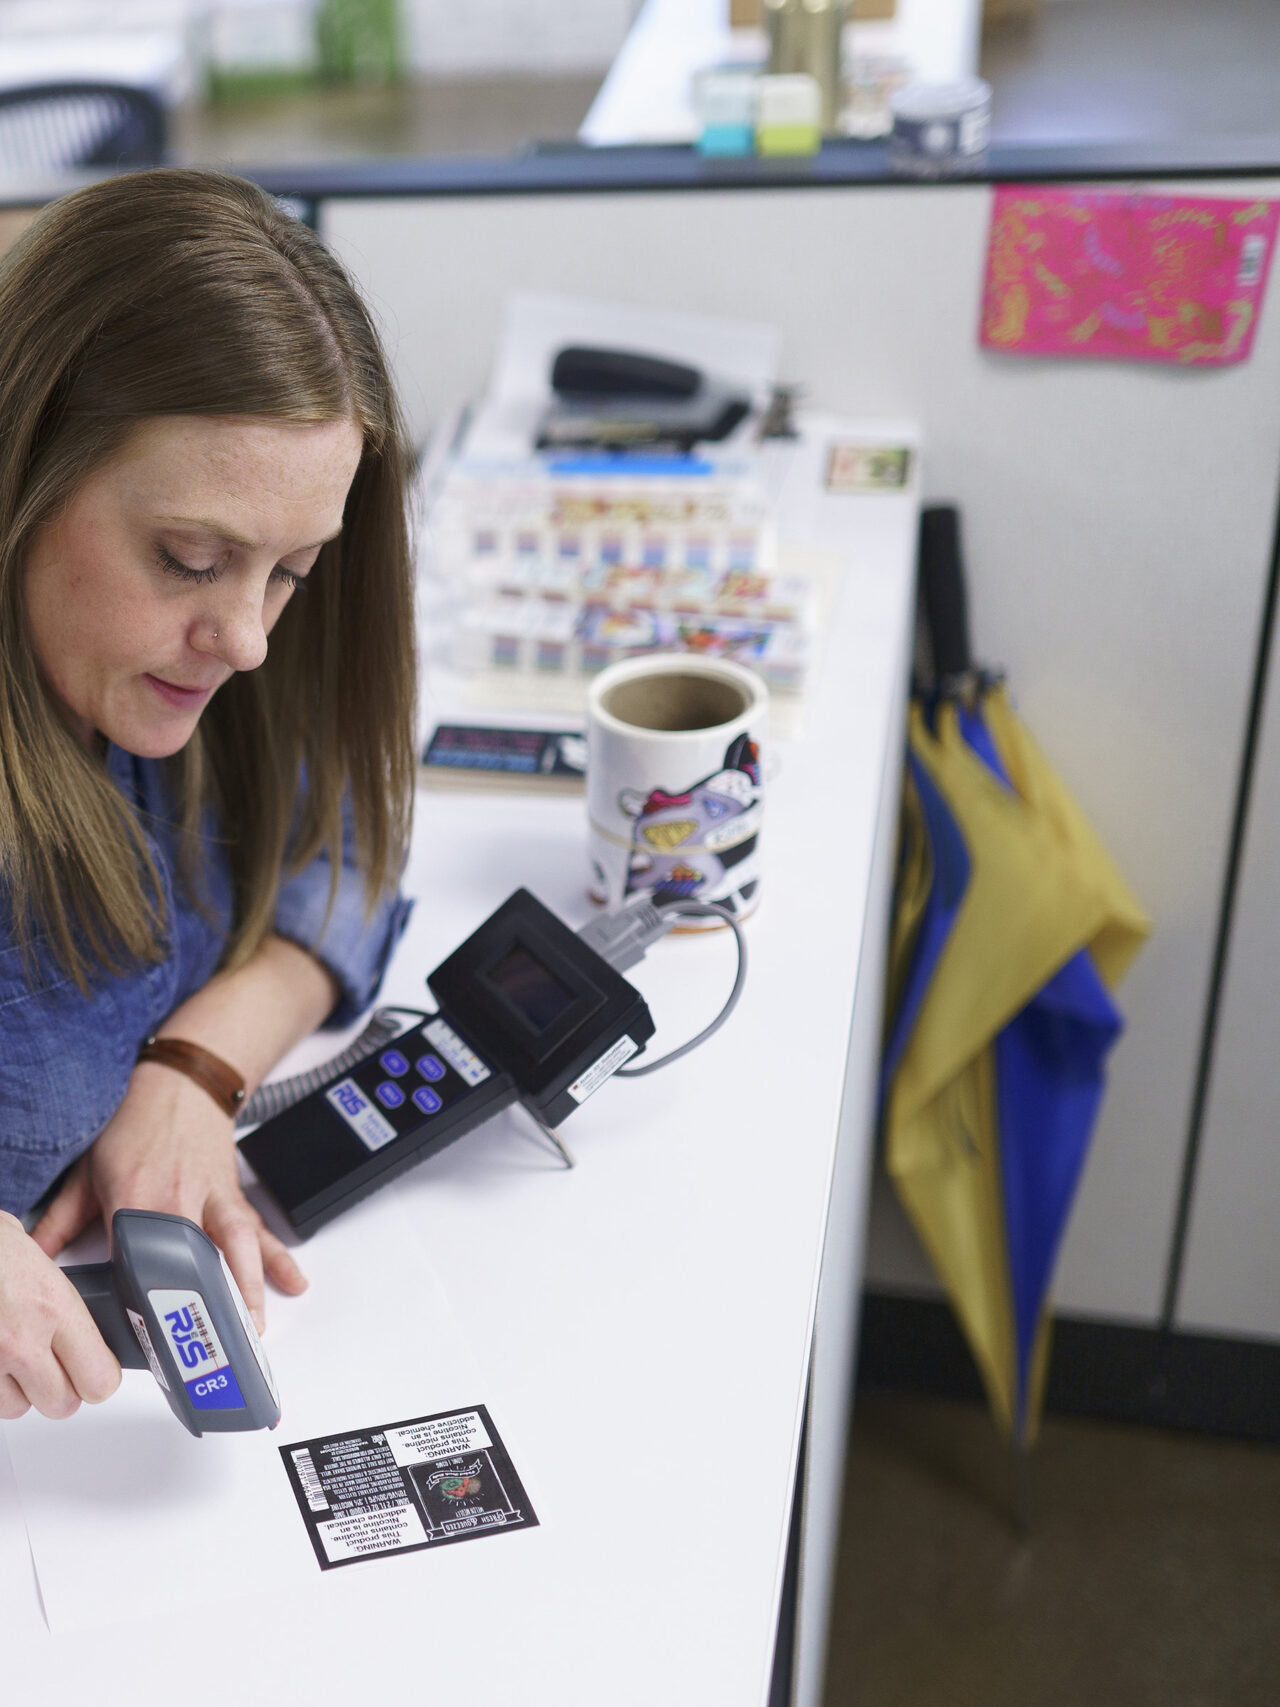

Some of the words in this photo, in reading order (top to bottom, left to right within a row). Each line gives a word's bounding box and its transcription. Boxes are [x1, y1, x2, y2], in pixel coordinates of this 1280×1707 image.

[333, 1082, 367, 1118] RJS
[164, 1307, 209, 1368] RJS
[195, 1374, 228, 1397] CR3
[437, 1415, 474, 1427] addictive
[394, 1424, 435, 1436] chemical.
[432, 1423, 467, 1435] Nicotine
[440, 1428, 476, 1440] contains
[402, 1436, 438, 1447] nicotine.
[416, 1440, 449, 1452] product
[451, 1436, 470, 1444] This
[422, 1443, 470, 1457] WARNING:
[329, 1499, 354, 1511] NICOTINE
[367, 1508, 406, 1520] addictive
[324, 1516, 365, 1530] chemical.
[362, 1517, 399, 1528] Nicotine
[370, 1522, 408, 1533] contains
[328, 1530, 368, 1541] nicotine.
[345, 1533, 379, 1546] product
[381, 1530, 400, 1538] This
[353, 1538, 401, 1552] WARNING:
